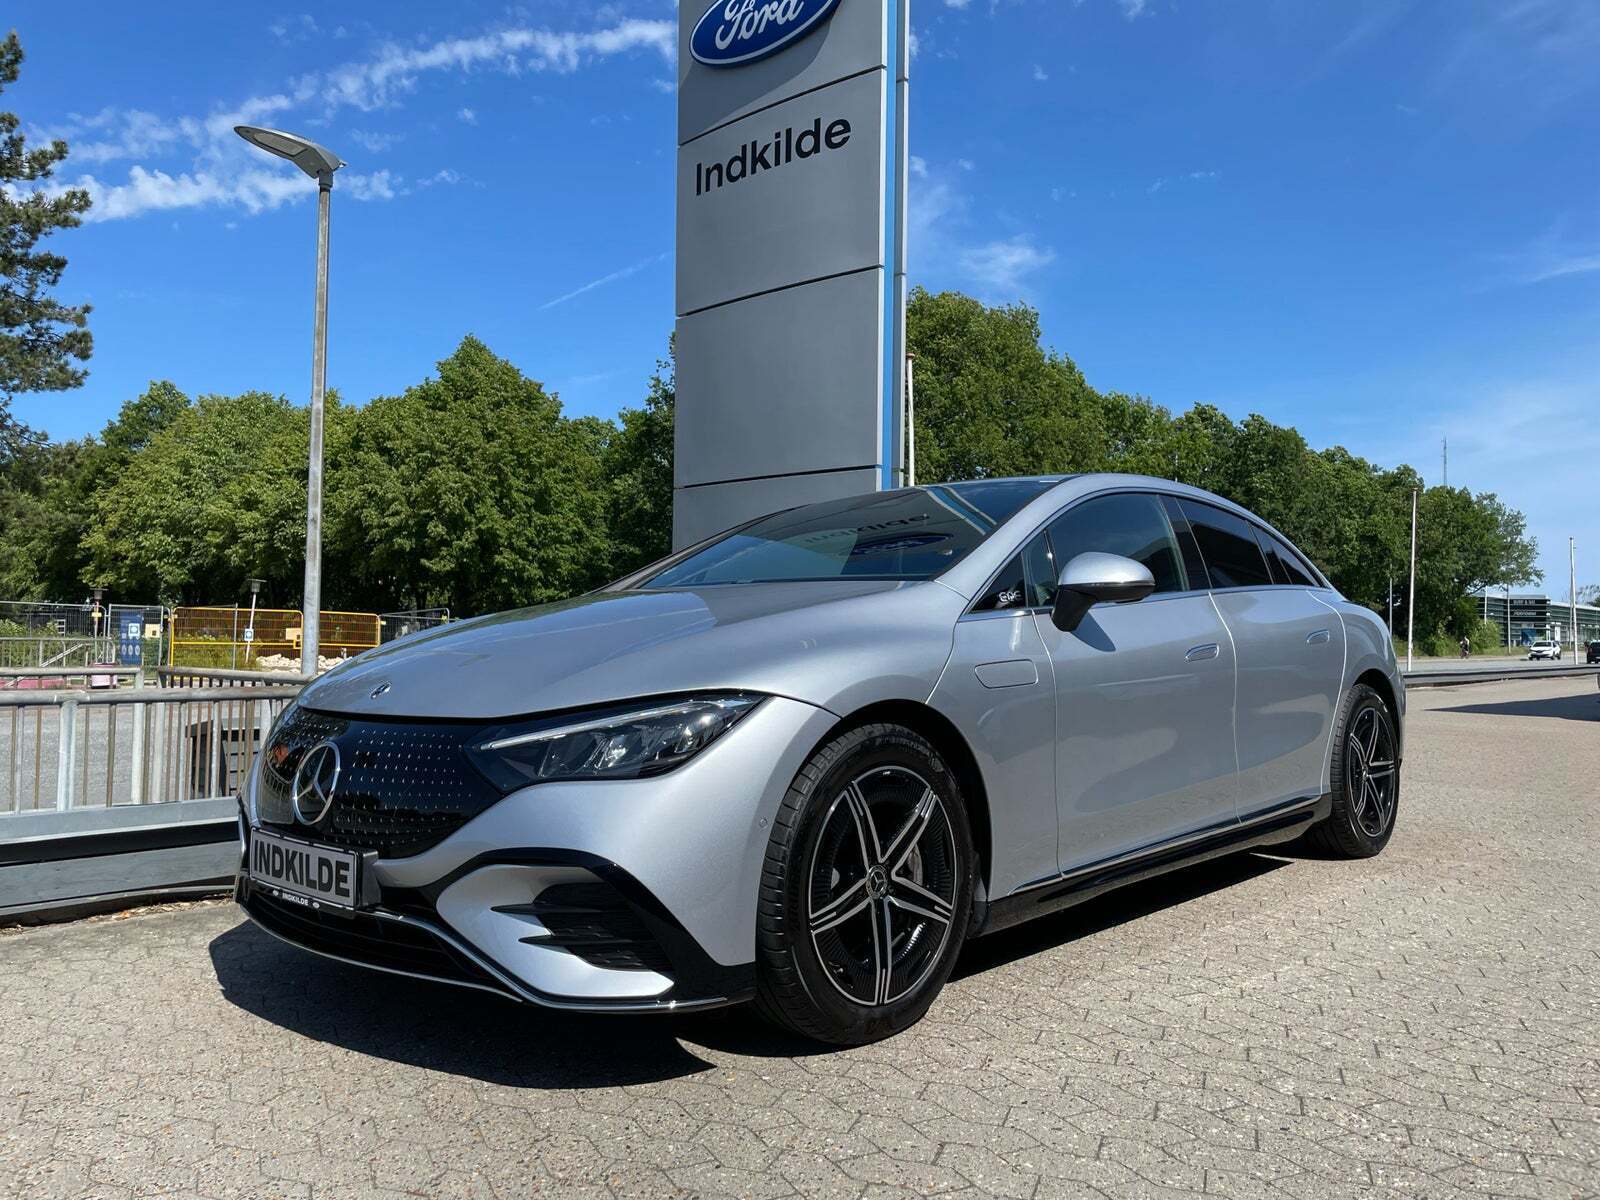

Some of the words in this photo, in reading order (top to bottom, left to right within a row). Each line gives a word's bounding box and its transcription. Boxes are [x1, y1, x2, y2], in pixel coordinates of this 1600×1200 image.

[696, 117, 852, 196] Indkilde
[254, 840, 350, 898] INDKILDE
[282, 892, 309, 906] INDKILDE
